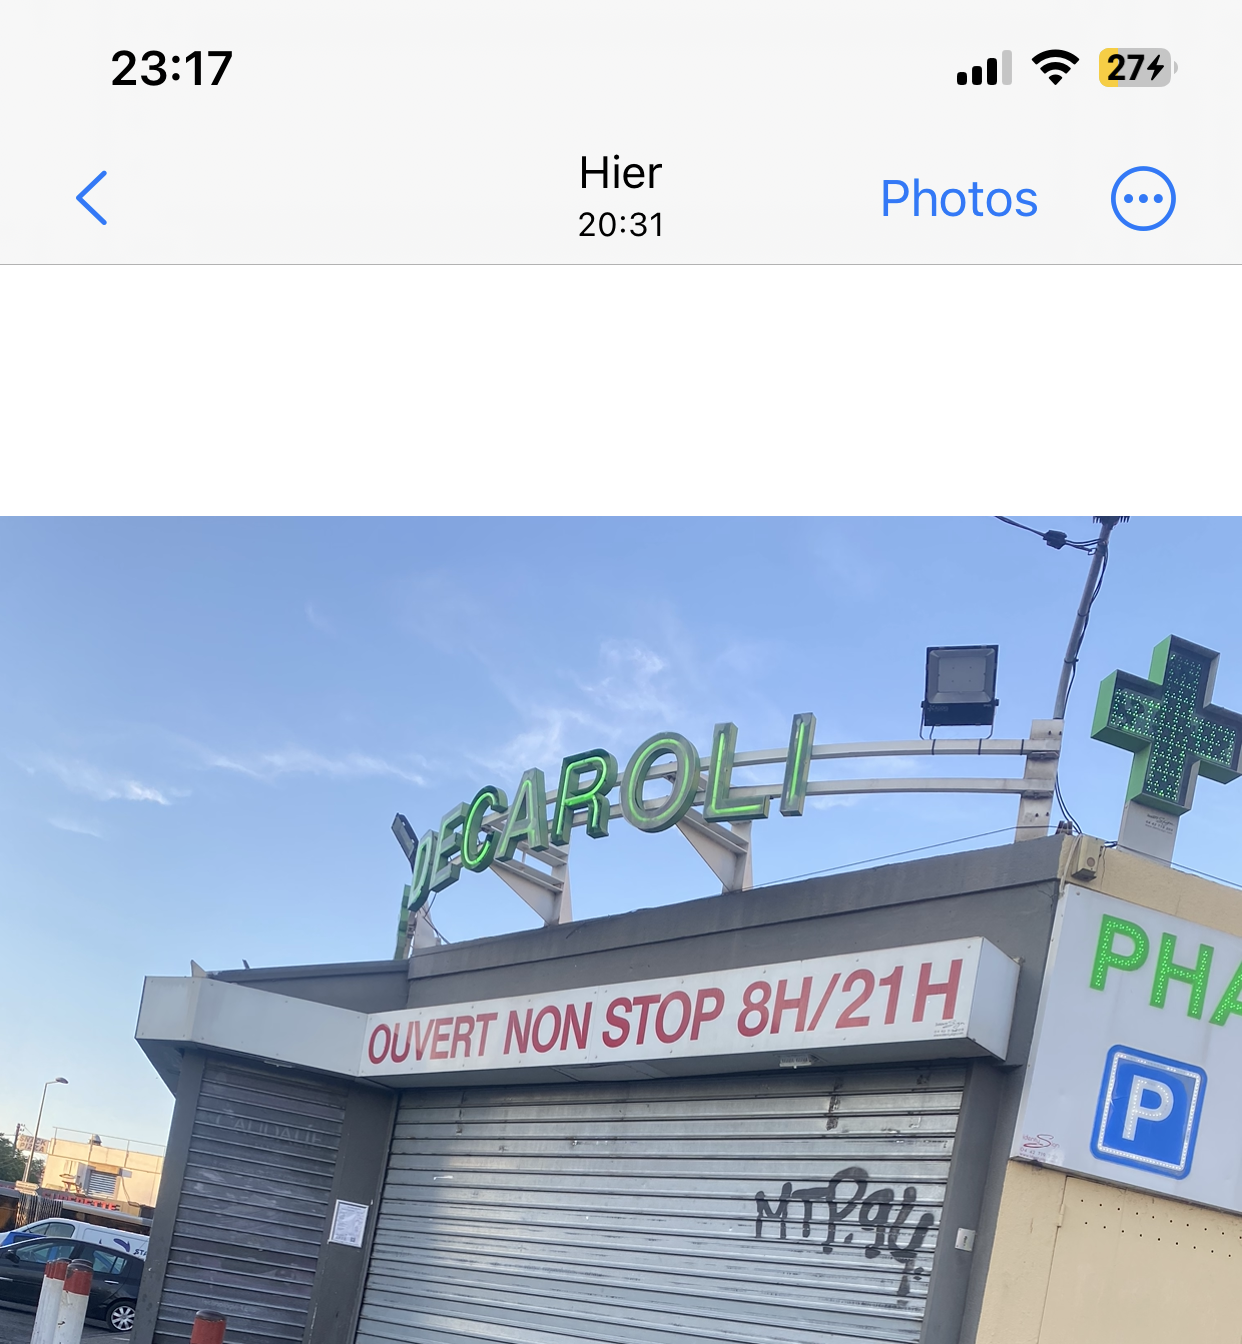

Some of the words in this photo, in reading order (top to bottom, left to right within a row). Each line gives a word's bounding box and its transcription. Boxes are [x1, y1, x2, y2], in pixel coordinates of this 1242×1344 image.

[112, 50, 232, 86] 23:17
[1108, 54, 1144, 80] 27
[582, 154, 662, 188] Hier
[883, 178, 1037, 217] Photos
[579, 212, 660, 237] 20:31
[408, 712, 817, 912] DECAROLI
[368, 1012, 498, 1064] OUVERT
[503, 1002, 592, 1055] NON
[602, 988, 725, 1047] STOP
[738, 959, 963, 1037] 8H/21H
[1122, 1074, 1174, 1141] P
